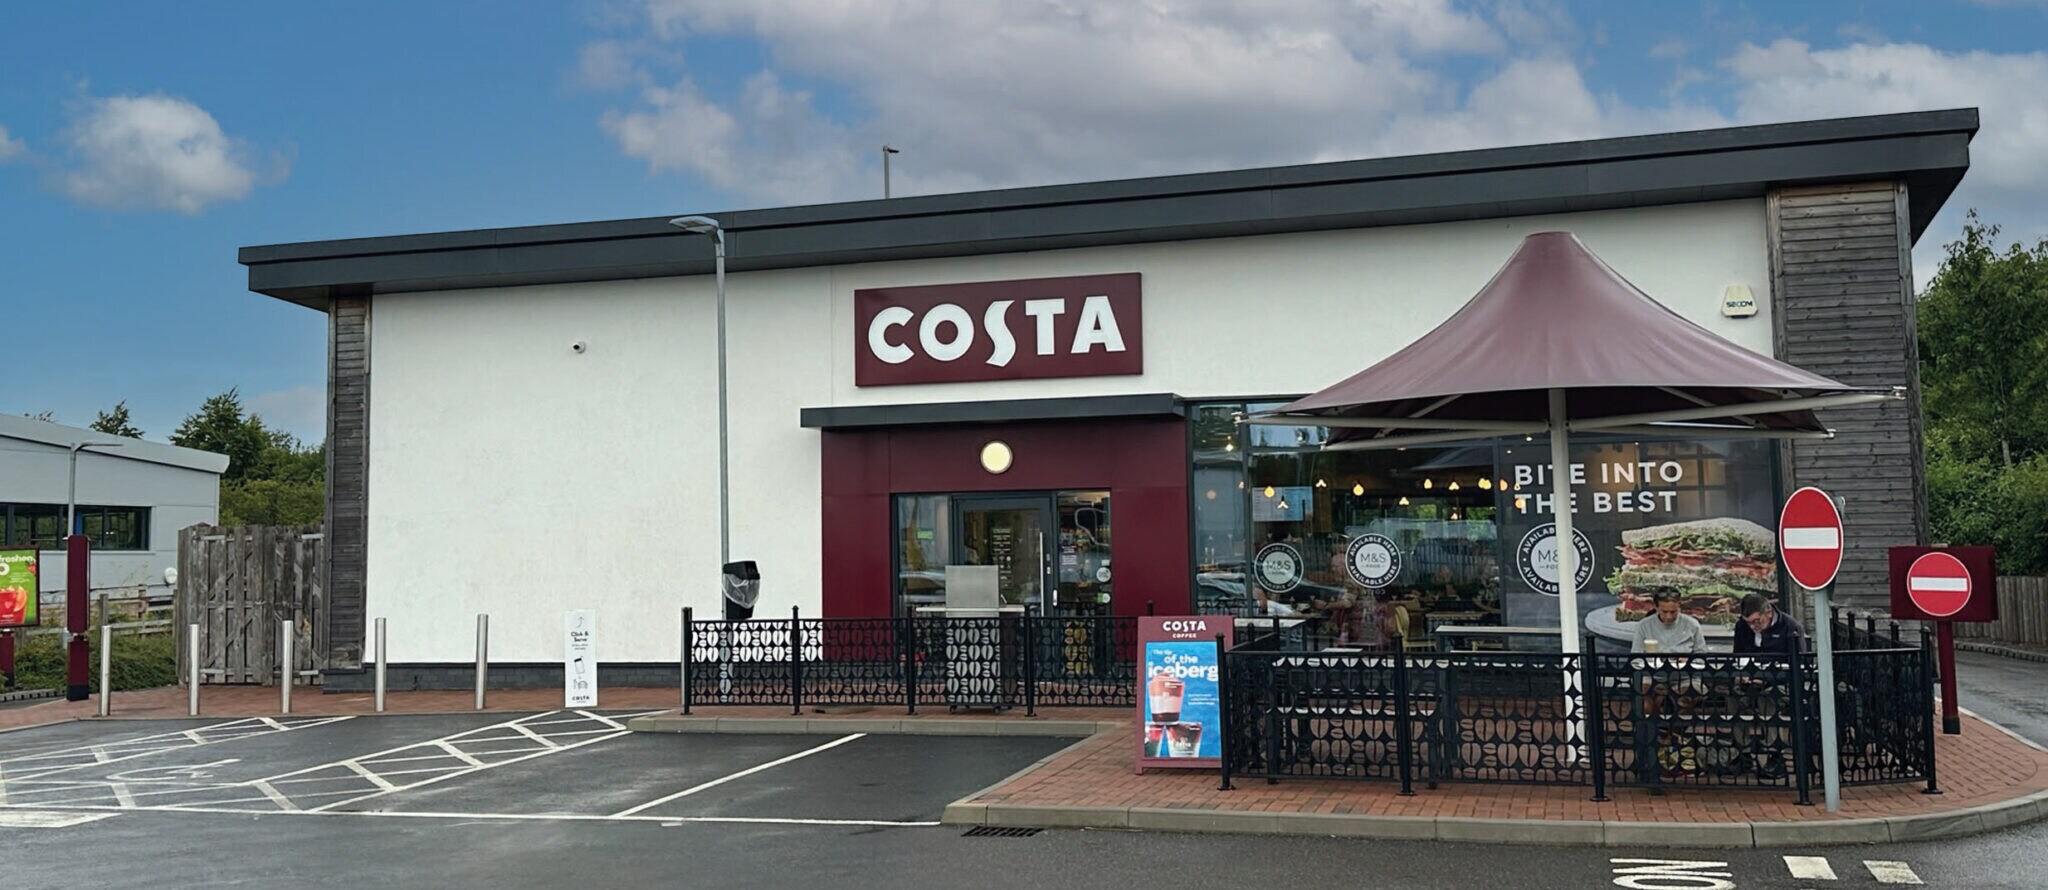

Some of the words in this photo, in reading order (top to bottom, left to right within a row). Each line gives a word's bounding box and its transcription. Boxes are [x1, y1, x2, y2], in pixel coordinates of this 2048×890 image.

[868, 295, 1126, 367] COSTA
[1514, 463, 1586, 485] BIE
[1601, 461, 1683, 484] INTO
[1593, 490, 1677, 513] BEST
[1522, 527, 1555, 554] AVAILAB
[1266, 560, 1291, 570] M&S
[1360, 553, 1386, 562] M&S
[1350, 565, 1383, 585] AVAILABLE
[1383, 565, 1397, 581] HERE
[1523, 566, 1558, 592] AVAILAB
[1162, 620, 1207, 632] COSTA
[1164, 653, 1177, 664] of
[1179, 654, 1199, 664] the
[1148, 661, 1218, 682] iceberg
